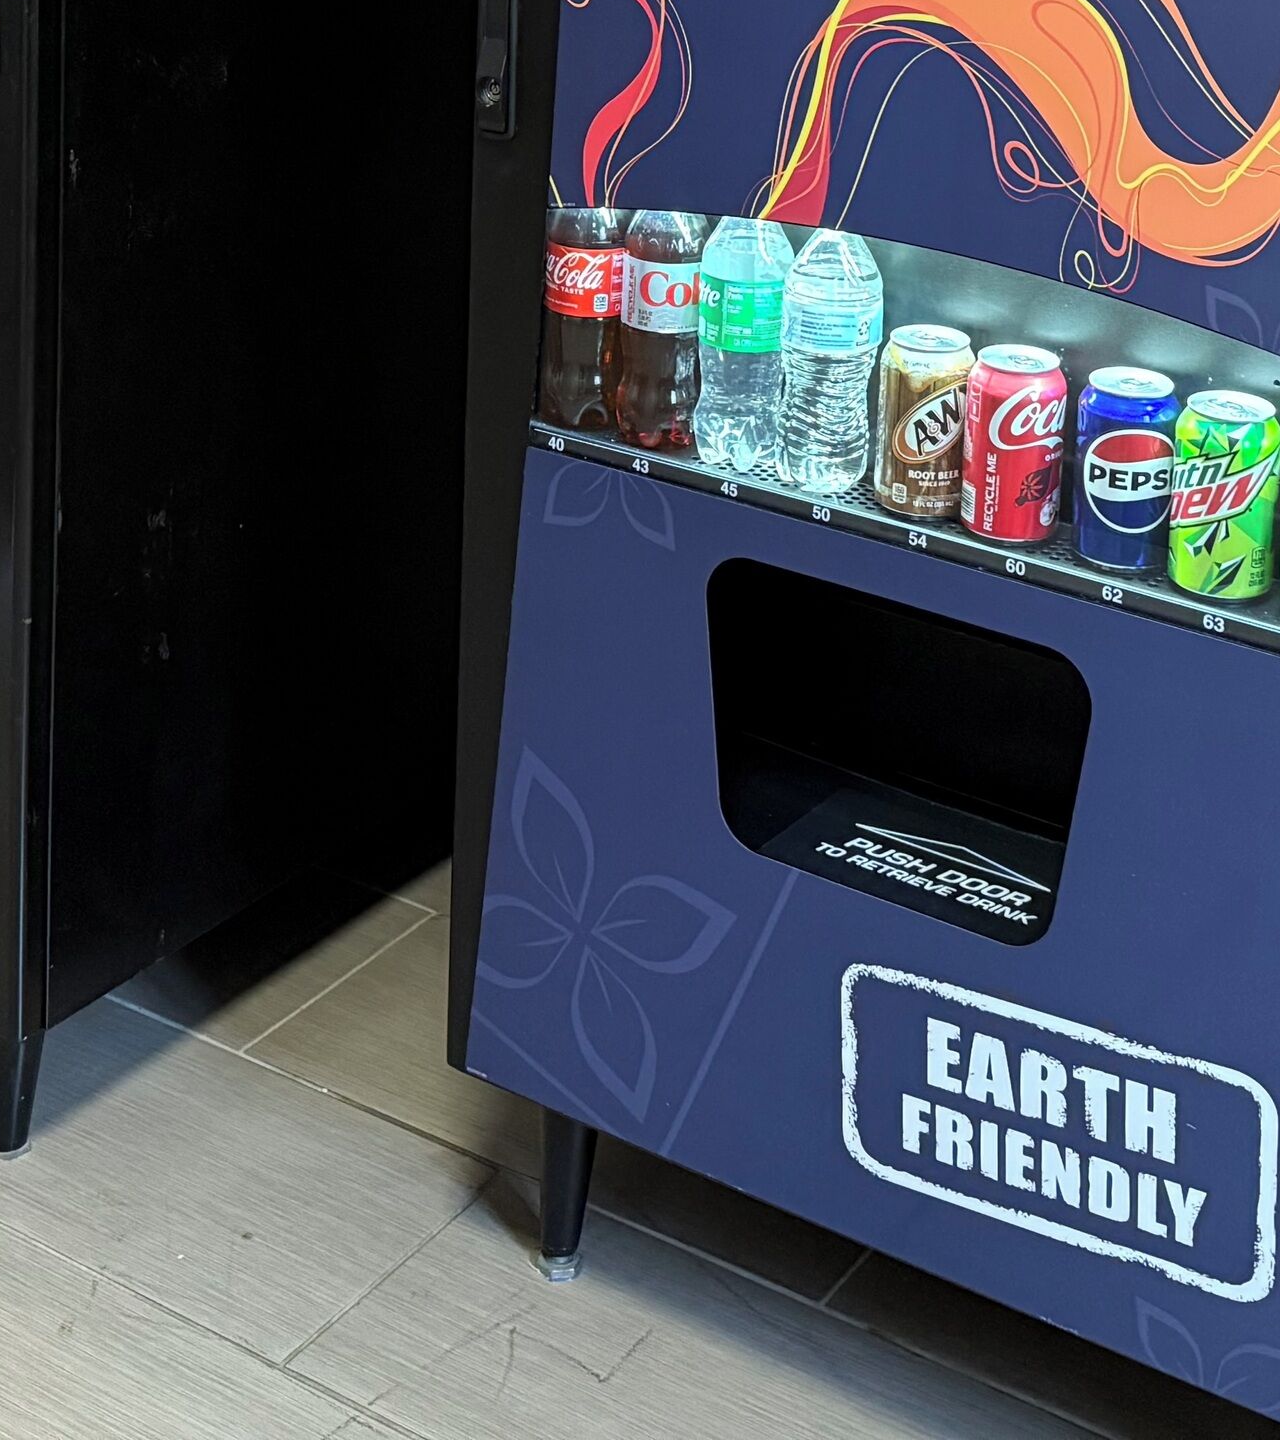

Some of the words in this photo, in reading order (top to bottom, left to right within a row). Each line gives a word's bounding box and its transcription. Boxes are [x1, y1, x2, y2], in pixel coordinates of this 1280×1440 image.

[913, 382, 967, 456] A&W
[548, 436, 565, 453] 40
[632, 459, 650, 475] 43
[987, 452, 997, 474] ME
[908, 469, 935, 479] ROOT
[937, 470, 960, 478] BEER
[1089, 462, 1168, 491] PEPS
[720, 482, 738, 498] 45
[812, 506, 831, 522] 50
[983, 477, 996, 532] RECYCLE
[908, 532, 927, 548] 54
[1005, 559, 1026, 577] 60
[1101, 586, 1124, 605] 62
[1202, 615, 1225, 633] 63
[843, 837, 937, 873] PUSH
[935, 869, 1032, 907] DOOR
[815, 842, 848, 858] TO
[845, 854, 958, 897] RETRIEVE
[955, 892, 1038, 926] DRINK
[926, 1017, 1177, 1165] EARTH
[901, 1093, 1208, 1247] FRIENDLY
